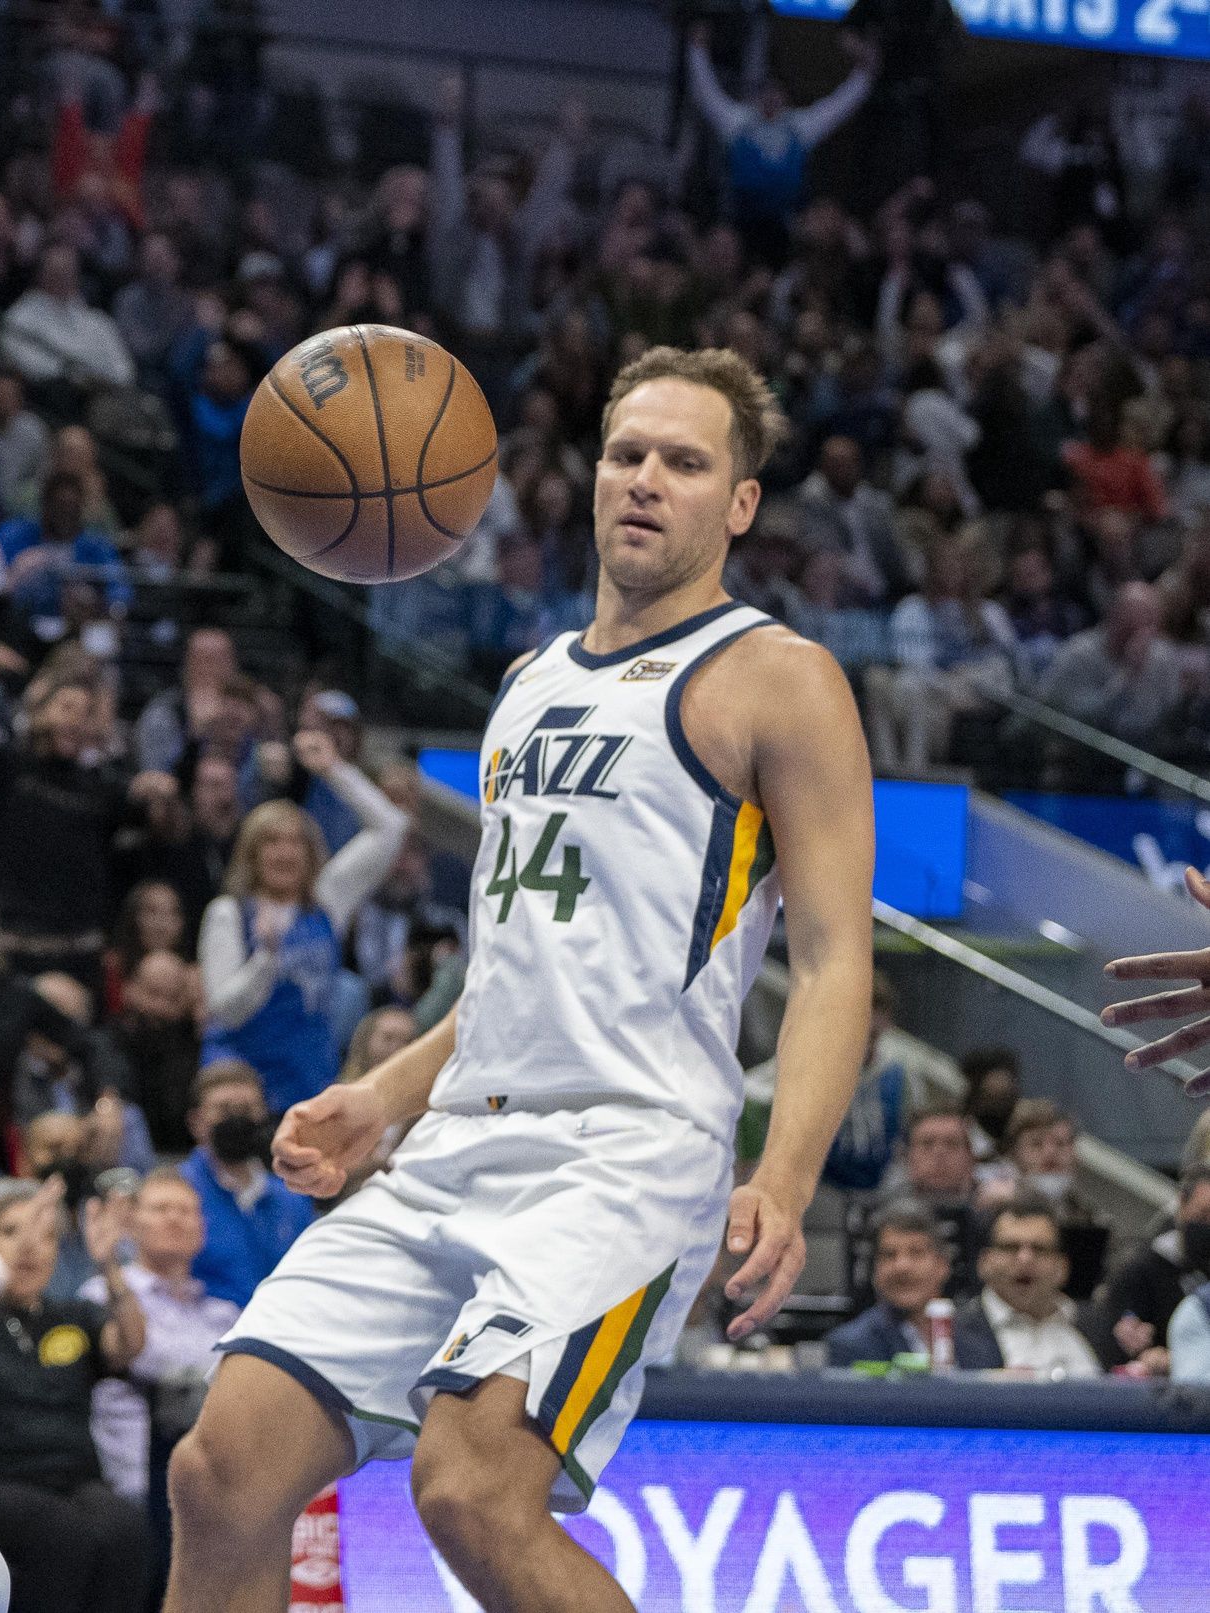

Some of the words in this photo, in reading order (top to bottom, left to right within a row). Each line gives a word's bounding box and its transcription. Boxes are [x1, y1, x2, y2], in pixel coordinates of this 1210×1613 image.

[484, 704, 634, 804] JAZZ
[485, 812, 592, 924] 44
[426, 1485, 1150, 1613] YAGER
